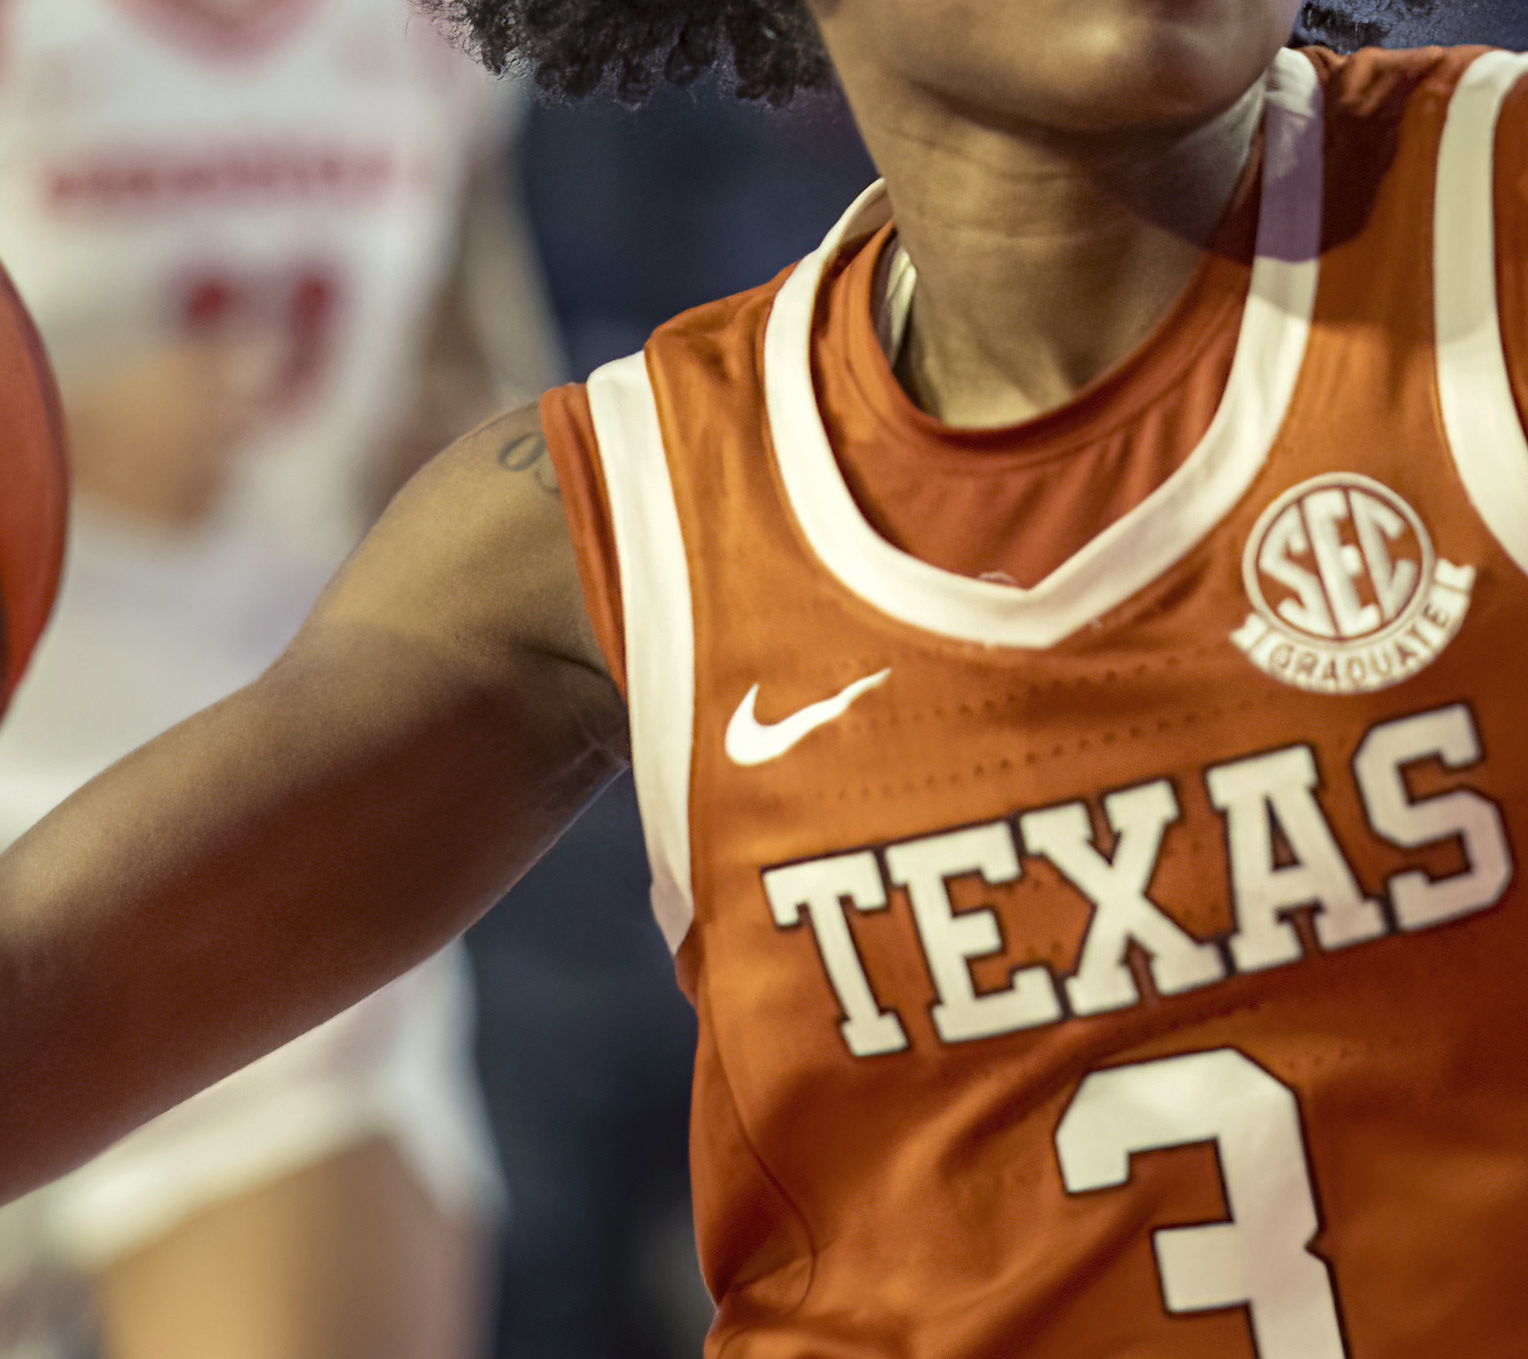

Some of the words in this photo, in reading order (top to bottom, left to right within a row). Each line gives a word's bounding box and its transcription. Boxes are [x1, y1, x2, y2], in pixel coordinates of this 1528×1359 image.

[1258, 487, 1418, 640] SEC
[1269, 602, 1452, 687] GRADUATE
[760, 700, 1516, 1059] TEXAS
